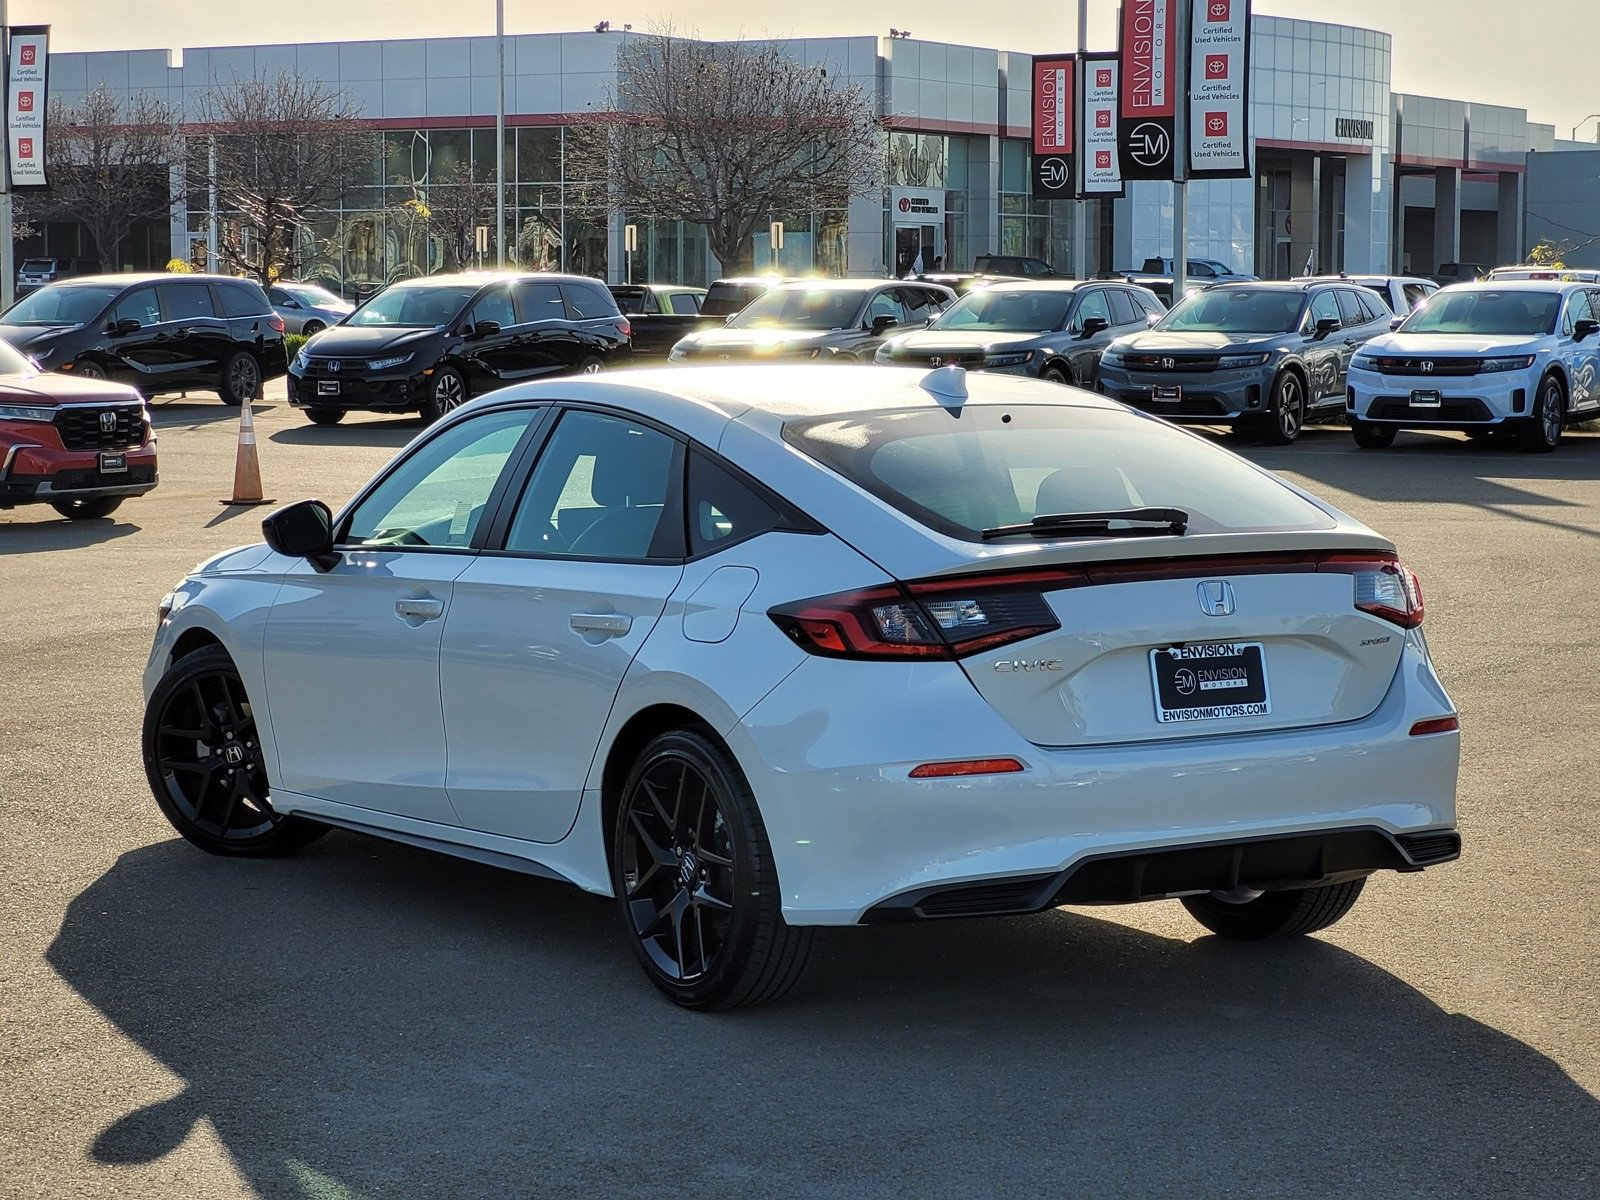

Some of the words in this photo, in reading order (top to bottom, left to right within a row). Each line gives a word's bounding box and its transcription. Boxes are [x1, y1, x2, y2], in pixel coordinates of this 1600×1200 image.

[1202, 27, 1233, 35] Certified
[1132, 0, 1152, 107] ENVISION
[1154, 8, 1164, 97] MOTORS
[1201, 84, 1232, 92] Certified
[1042, 69, 1055, 147] ENVISION
[1335, 118, 1373, 140] ENVISION
[1201, 141, 1232, 149] Certified
[1212, 150, 1240, 158] Vehicles
[1180, 644, 1235, 659] ENVISION
[993, 659, 1063, 672] CIVIC
[1197, 667, 1248, 682] ENVISION
[1163, 703, 1268, 721] ENVISIONMOTORS.COM
